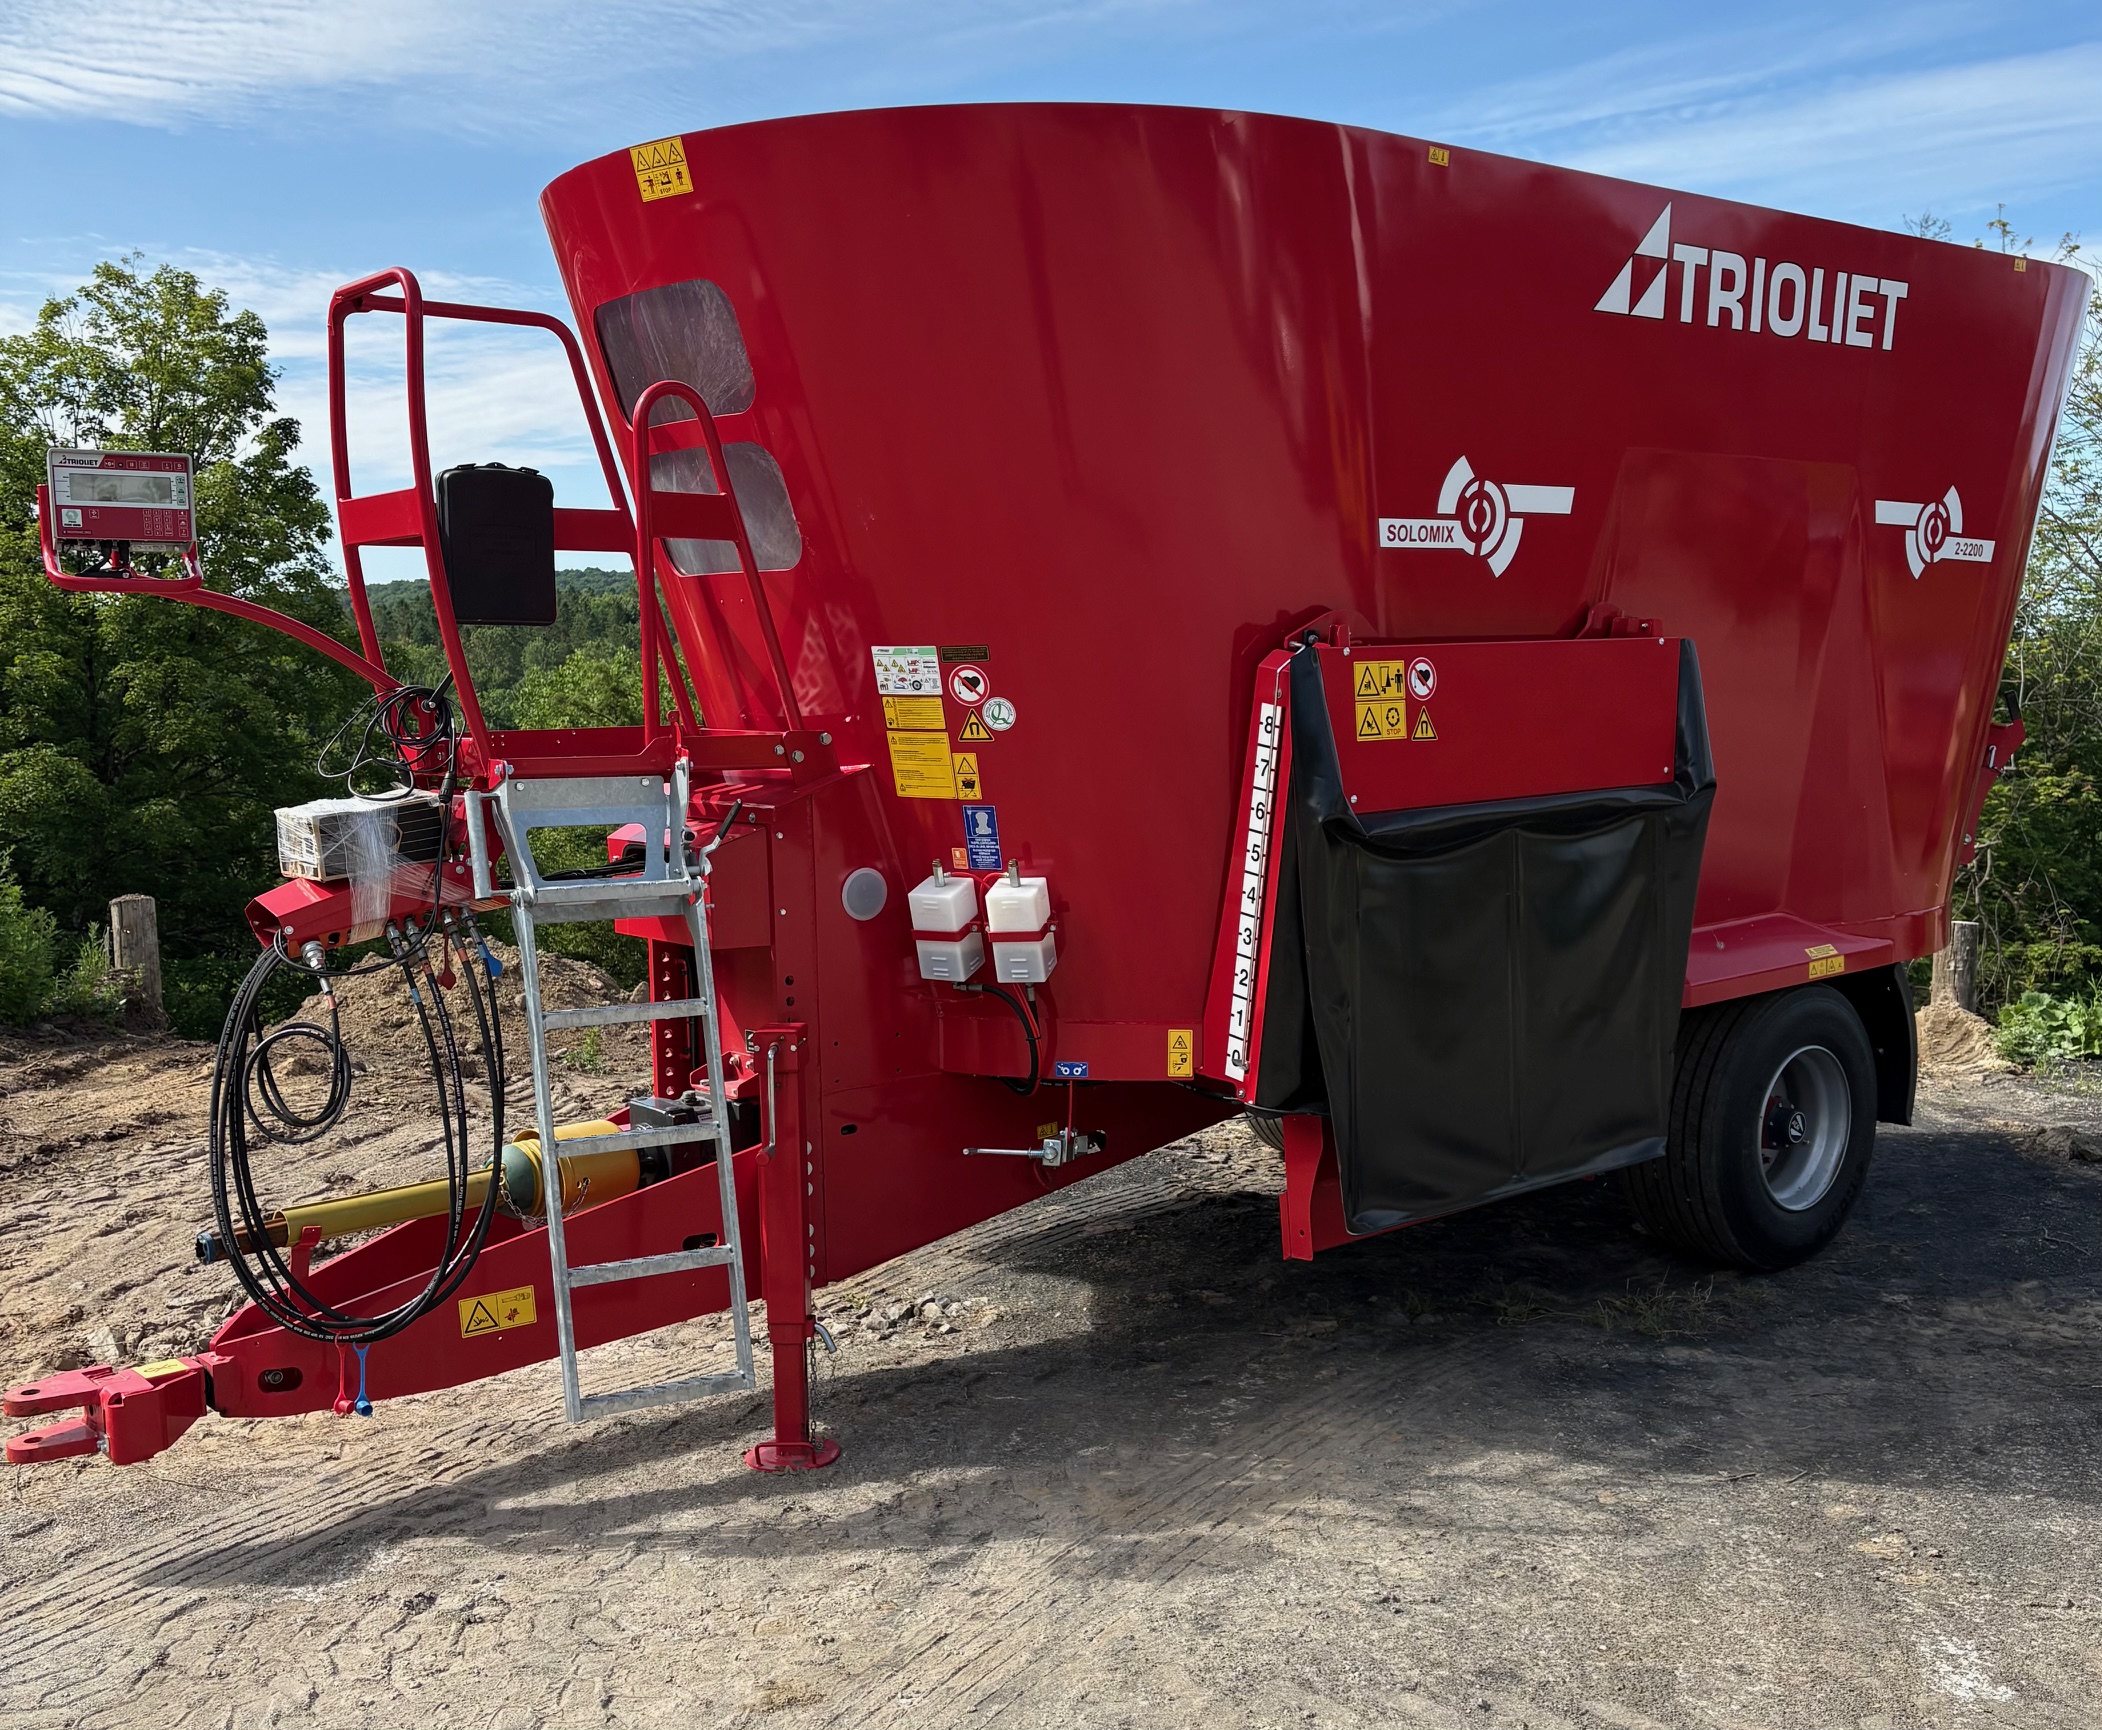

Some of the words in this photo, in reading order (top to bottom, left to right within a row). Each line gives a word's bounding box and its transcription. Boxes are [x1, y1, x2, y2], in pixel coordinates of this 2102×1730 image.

[1673, 243, 1908, 350] TRIOLIET
[1386, 524, 1454, 543] SOLOMIX
[1954, 542, 1984, 557] 2-2200
[1264, 716, 1273, 734] 8
[1260, 758, 1270, 776] 7
[1255, 801, 1265, 820] 6
[1250, 844, 1261, 862] 5
[1246, 886, 1256, 904] 4
[1242, 927, 1252, 945] 3
[1239, 968, 1248, 987] 2
[1236, 1009, 1243, 1026] 1
[1231, 1049, 1241, 1067] 0
